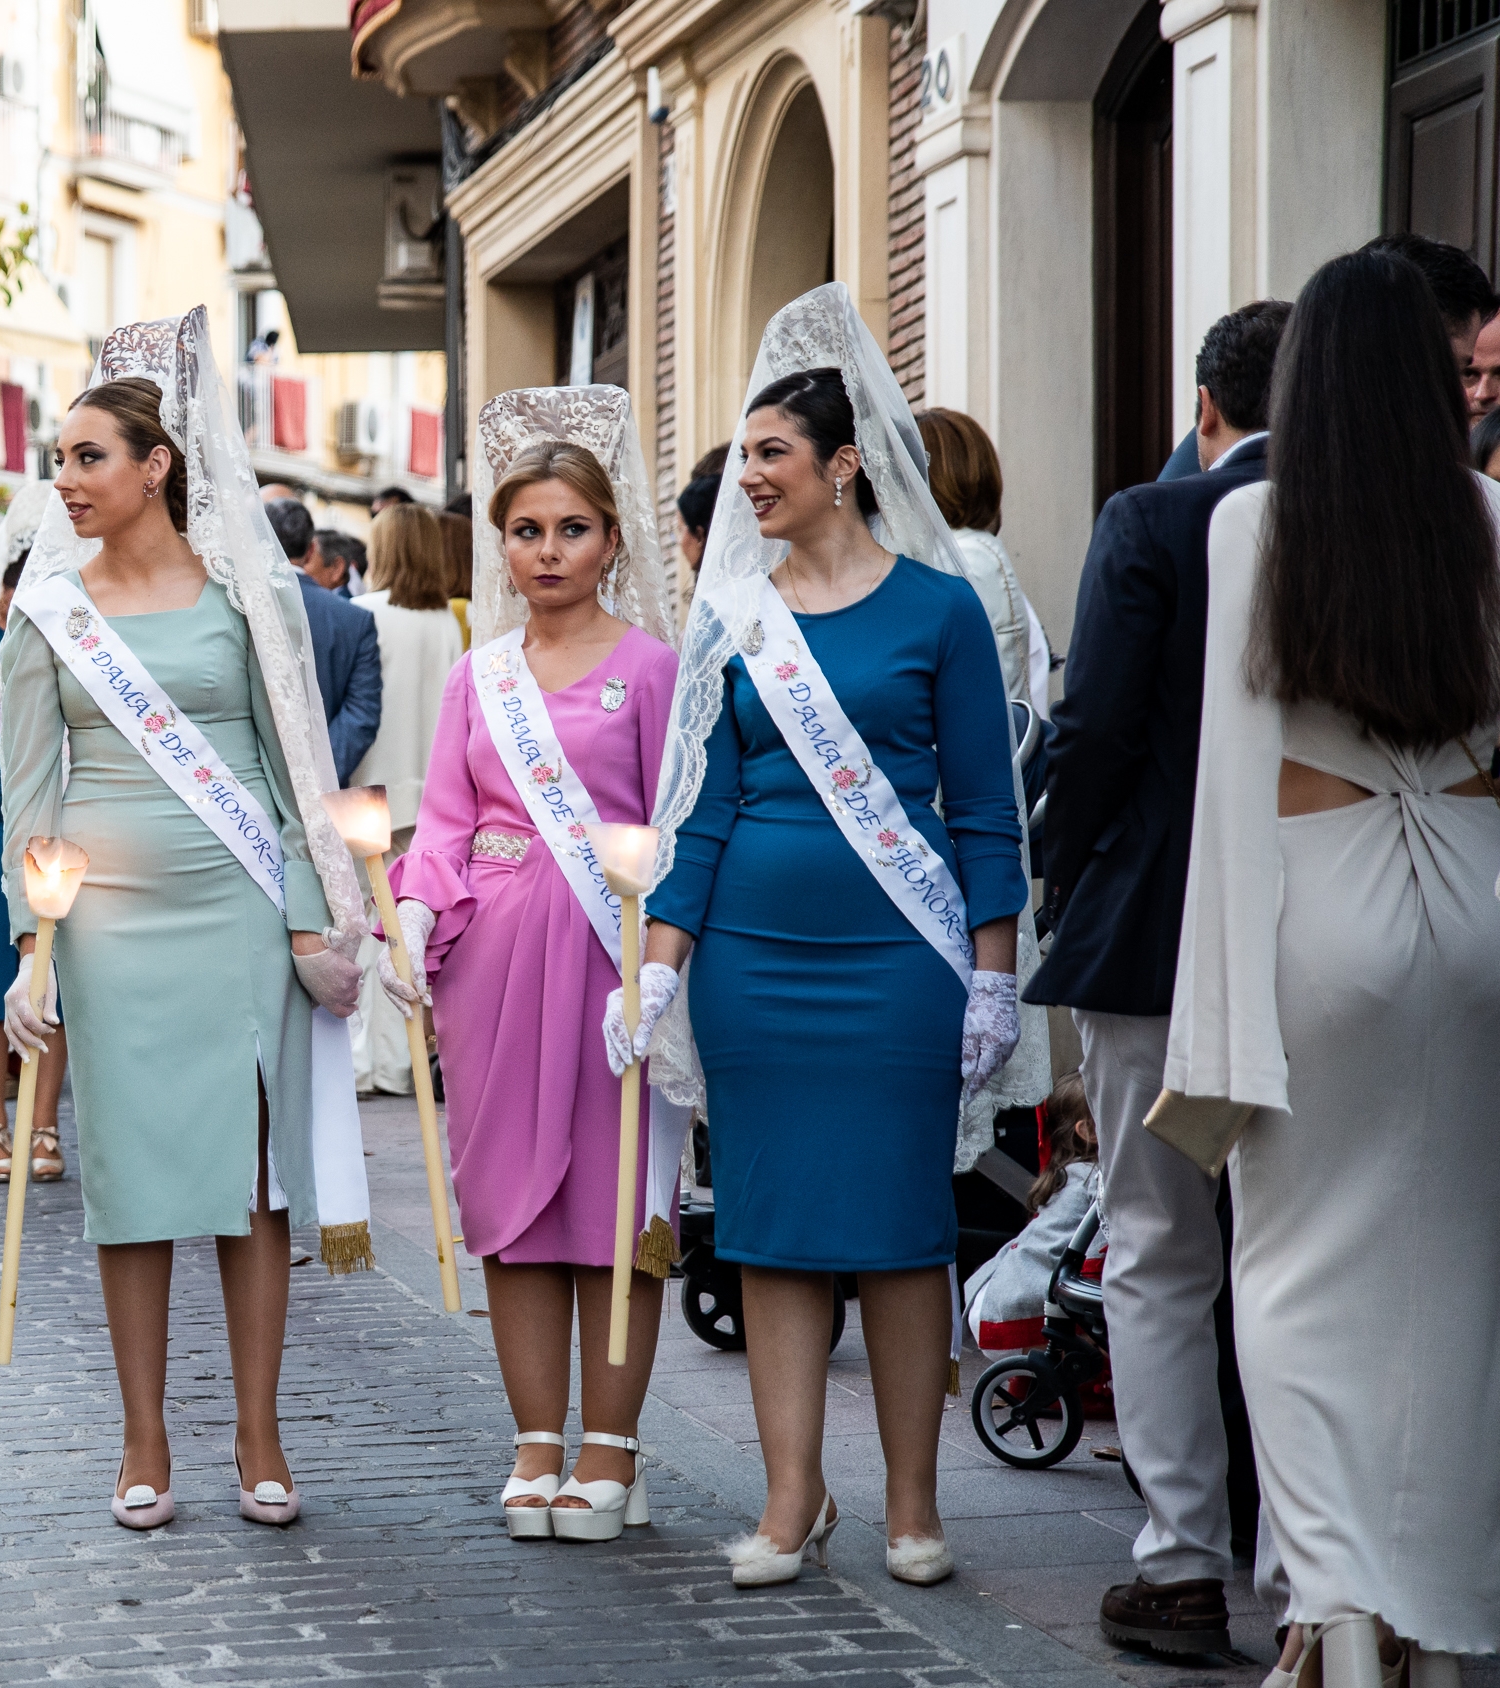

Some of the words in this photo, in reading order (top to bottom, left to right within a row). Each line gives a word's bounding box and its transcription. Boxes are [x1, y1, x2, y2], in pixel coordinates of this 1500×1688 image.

[921, 58, 950, 109] 20
[91, 651, 152, 719] DAMA
[159, 732, 197, 768] DE
[503, 696, 542, 767] DAMA
[541, 786, 575, 823] DE
[788, 683, 843, 770] DAMA
[843, 791, 882, 831] DE
